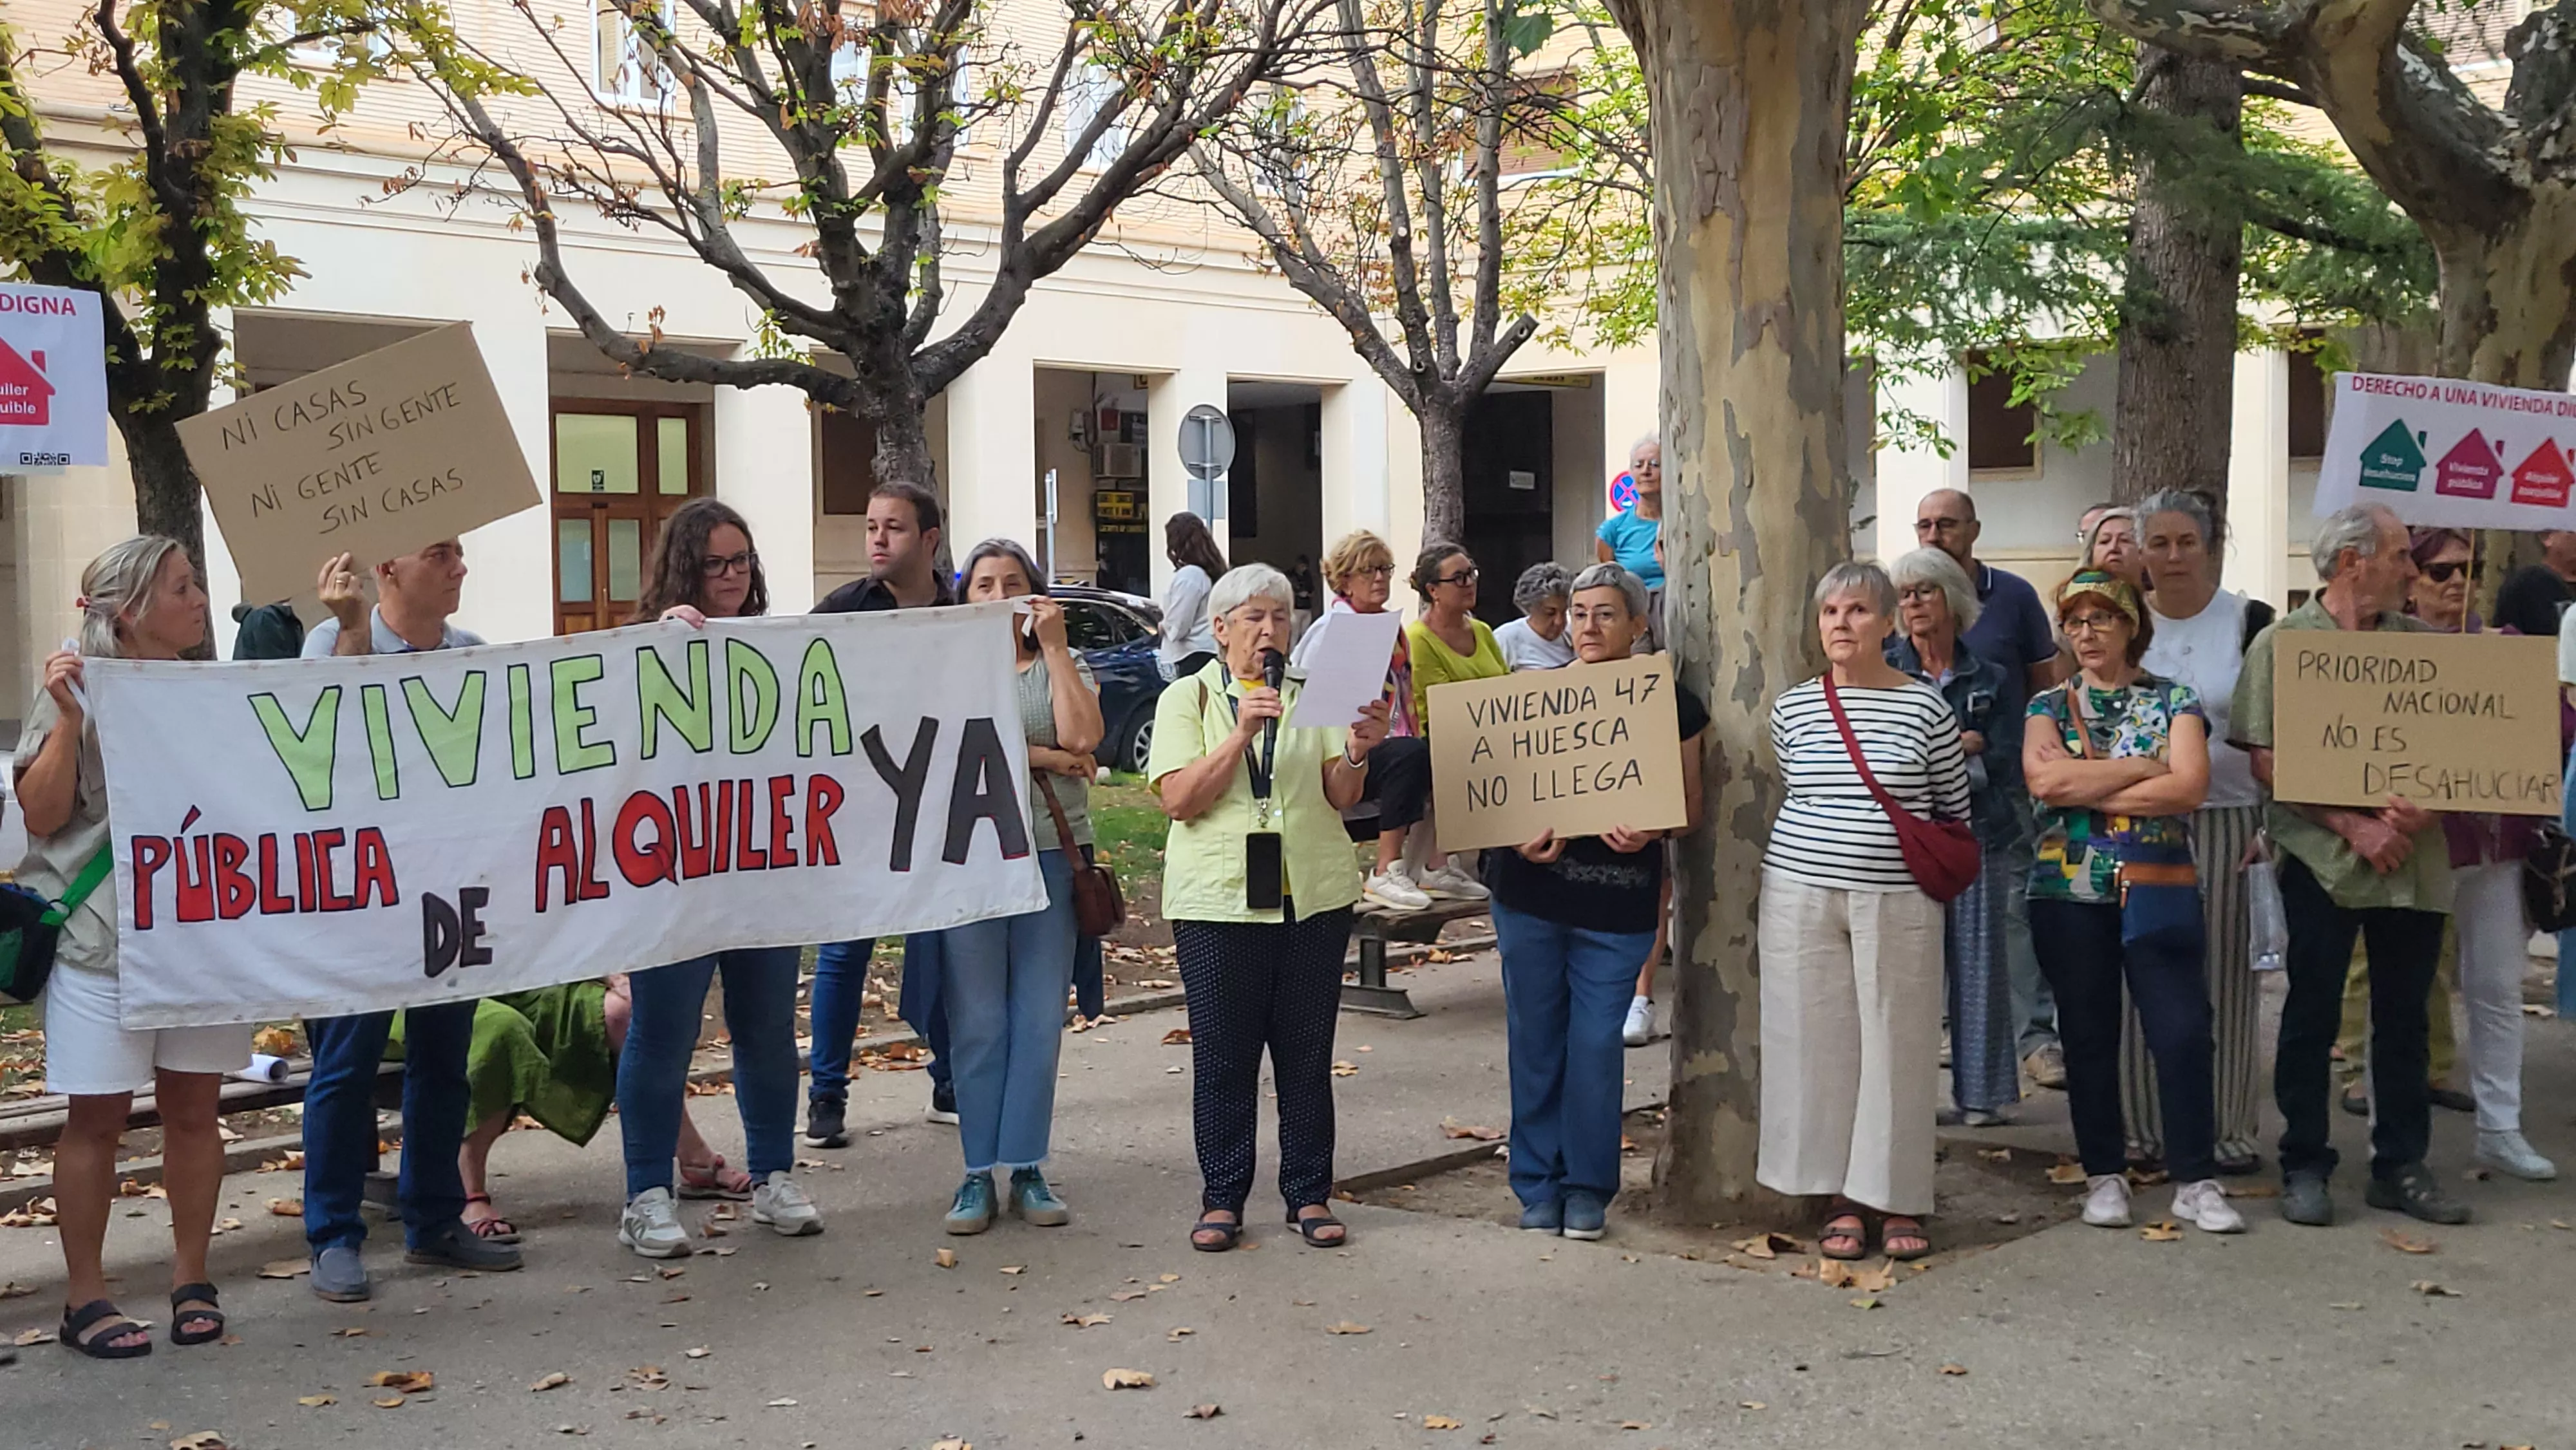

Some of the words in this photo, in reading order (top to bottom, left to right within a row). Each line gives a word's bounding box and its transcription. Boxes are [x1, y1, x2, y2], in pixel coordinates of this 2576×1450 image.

[0, 294, 76, 316] DIGNA
[275, 380, 366, 431] CASAS
[381, 382, 461, 430] GENTE
[2352, 376, 2427, 399] DERECHO
[2430, 386, 2440, 401] A
[2446, 388, 2477, 406] UNA
[2482, 393, 2554, 414] VIVIENDA
[298, 452, 383, 500] GENTE
[319, 496, 368, 534] SIN
[383, 467, 463, 513] CASAS
[2298, 650, 2437, 685] PRIORIDAD
[247, 637, 853, 811] VIVIENDA
[1466, 685, 1596, 728] VIVIENDA
[1615, 673, 1661, 705] 47
[2383, 687, 2516, 720] NACIONAL
[1471, 736, 1493, 764] A
[1513, 717, 1629, 759] HUESCA
[2322, 714, 2358, 749] NO
[2371, 724, 2407, 752] ES
[860, 716, 1029, 872] YA
[1467, 775, 1508, 812] NO
[1533, 759, 1642, 802] LLEGA
[2364, 762, 2559, 804] DESAHUCIAR
[131, 805, 399, 930] PÚBLICA
[421, 887, 493, 977] DE
[535, 773, 845, 912] ALQUILER
